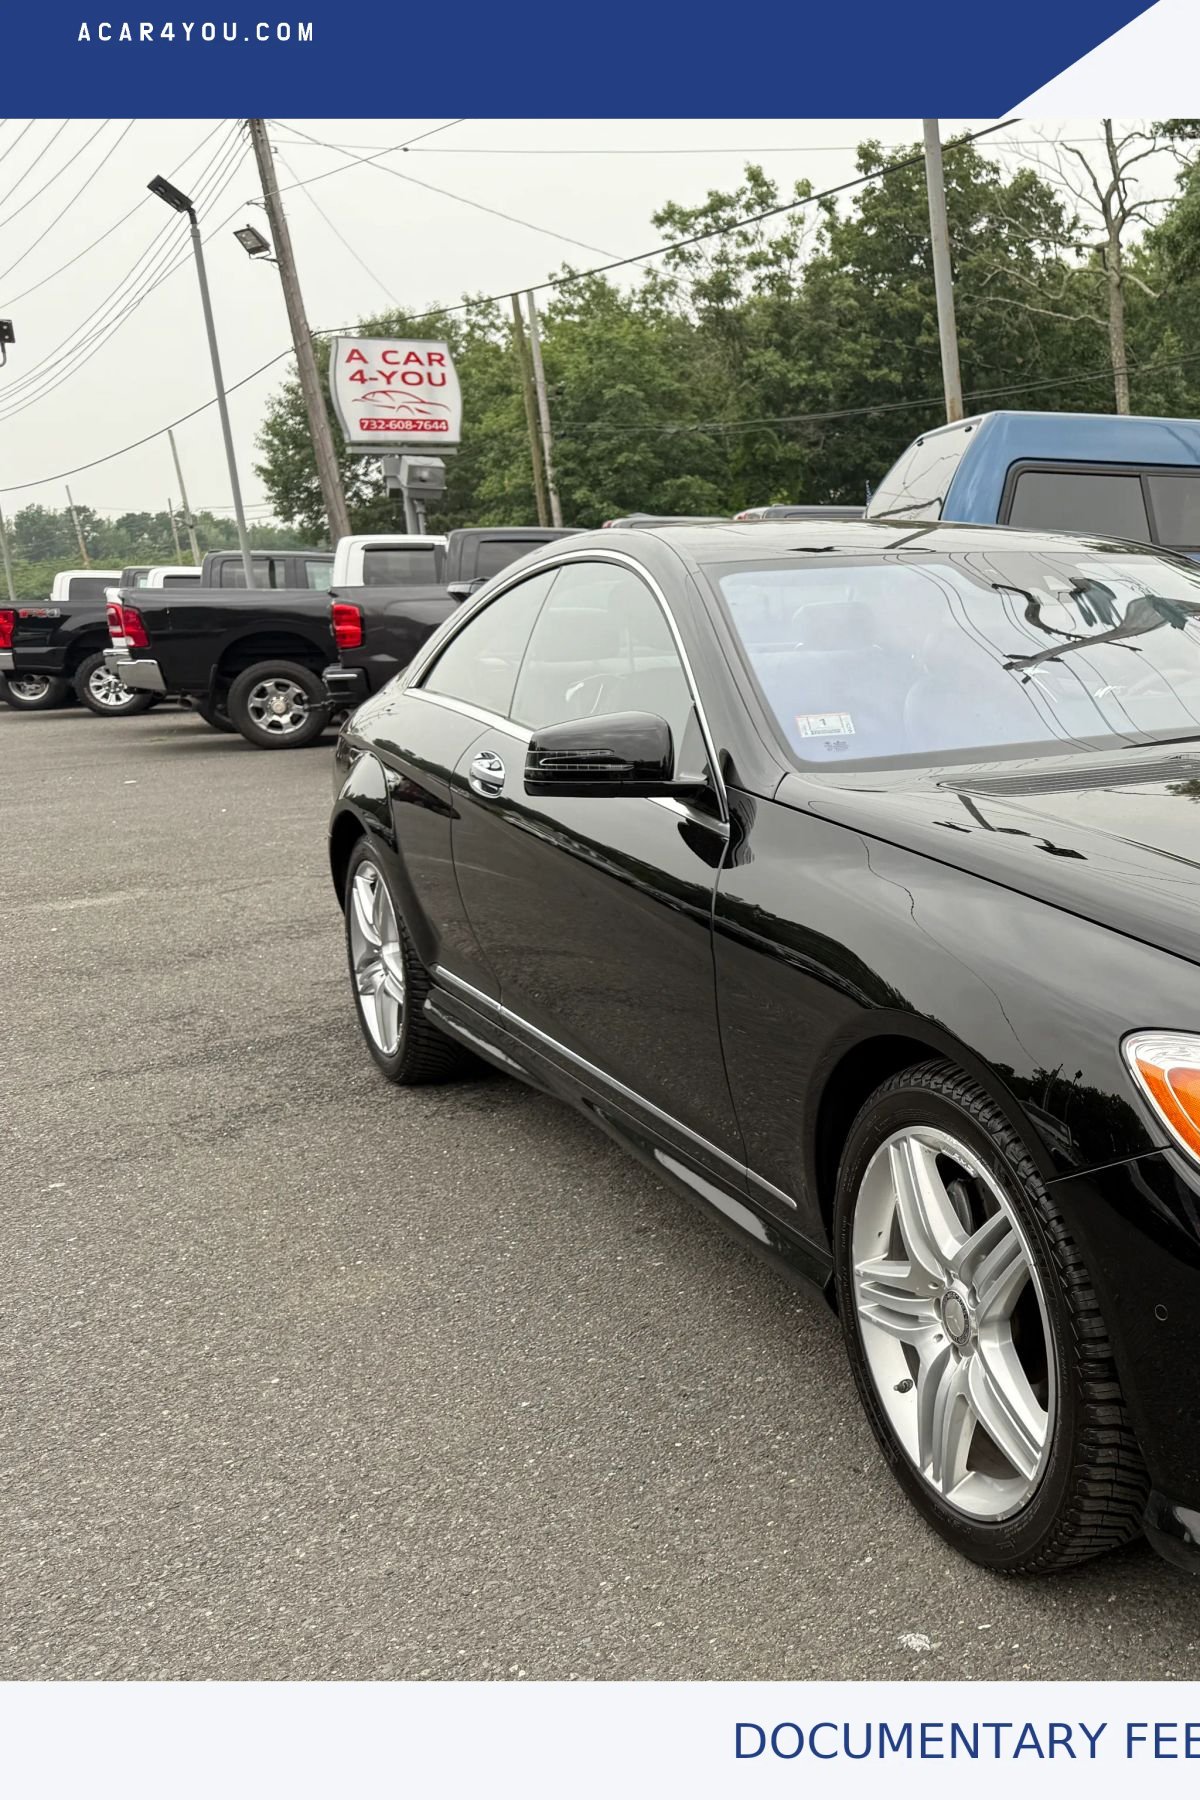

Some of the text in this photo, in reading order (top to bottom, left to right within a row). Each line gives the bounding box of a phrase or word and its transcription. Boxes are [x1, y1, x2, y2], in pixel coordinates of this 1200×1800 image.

[345, 348, 446, 367] A CAR
[349, 369, 446, 387] 4-YOU
[361, 420, 447, 431] 732-608-7644
